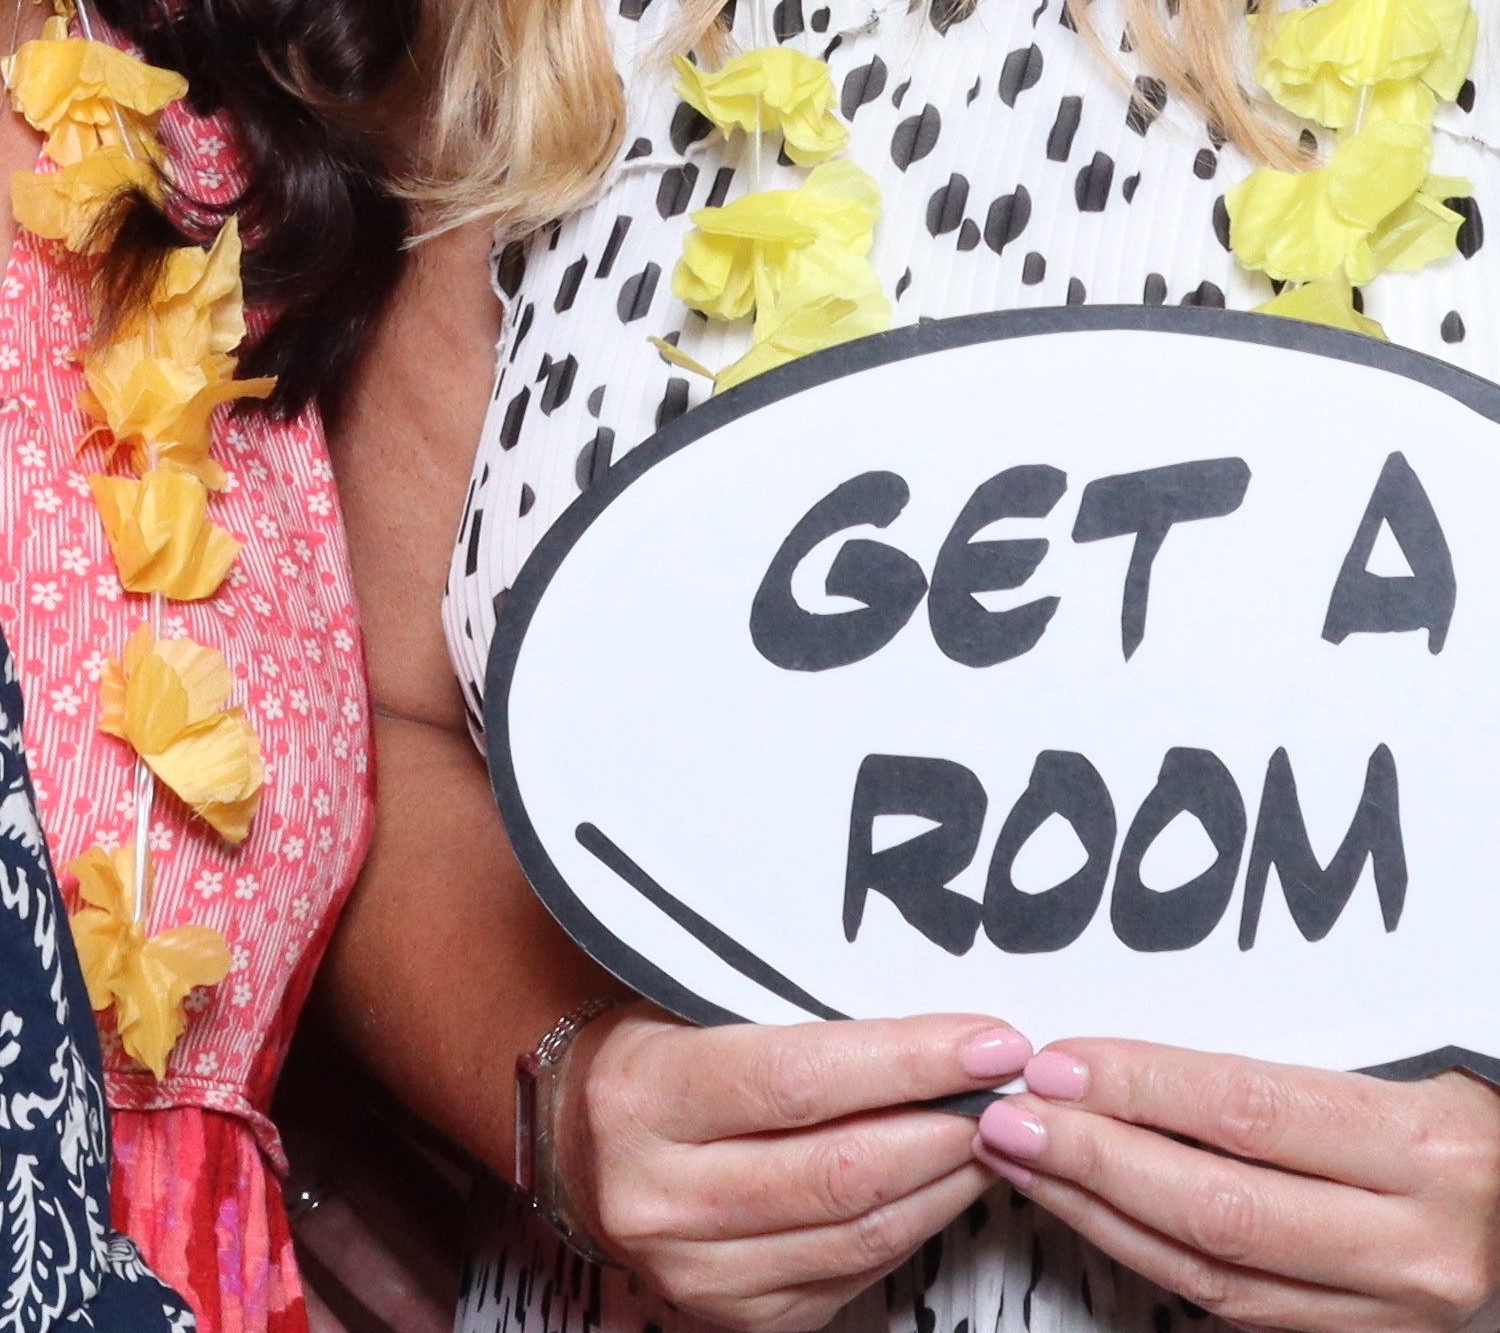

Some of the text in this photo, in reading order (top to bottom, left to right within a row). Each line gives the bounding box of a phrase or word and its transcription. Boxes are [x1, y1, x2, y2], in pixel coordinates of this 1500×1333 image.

[749, 450, 1457, 673] GET A
[842, 742, 1408, 956] ROOM
